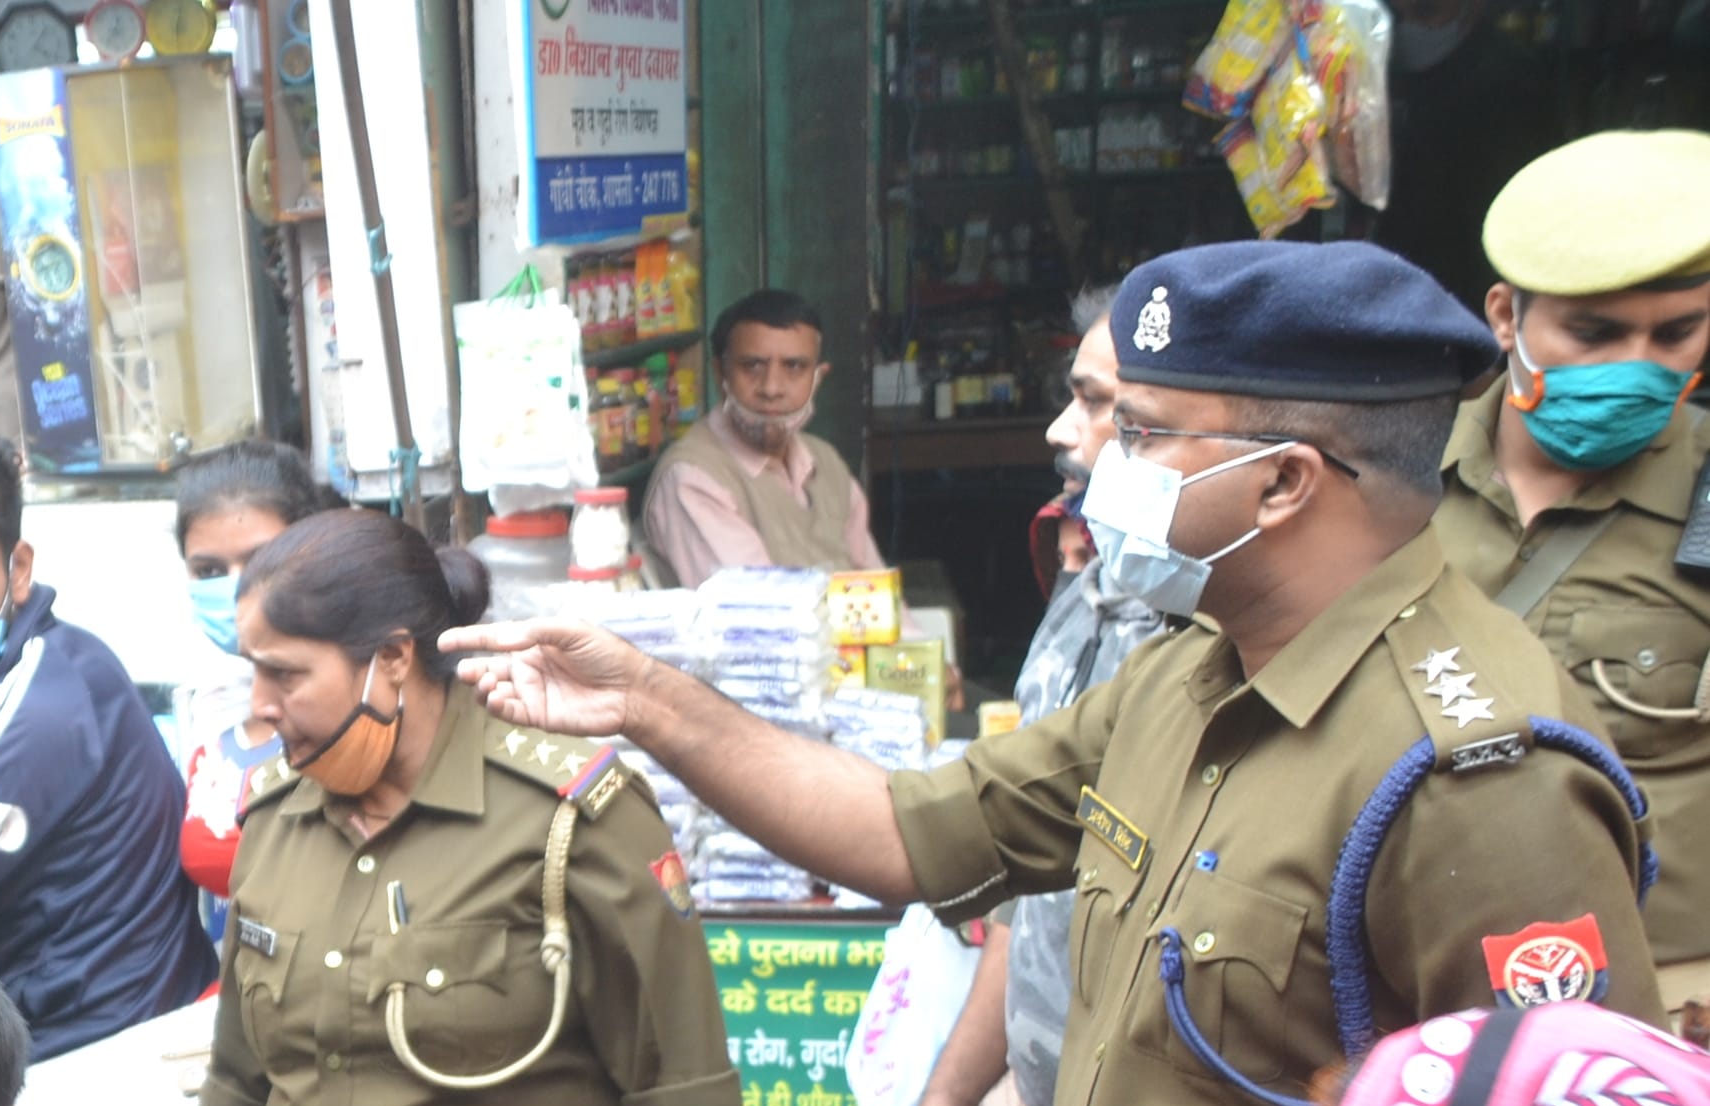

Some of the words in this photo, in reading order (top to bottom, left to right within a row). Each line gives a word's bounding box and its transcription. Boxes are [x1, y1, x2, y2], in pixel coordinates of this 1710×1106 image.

[615, 45, 641, 93] गुप्ता
[708, 929, 741, 966] से
[747, 938, 839, 977] पुराना
[721, 979, 758, 1013] के
[766, 979, 818, 1015] दर्द
[745, 1027, 794, 1069] रोग,
[800, 1028, 848, 1082] गुर्दा
